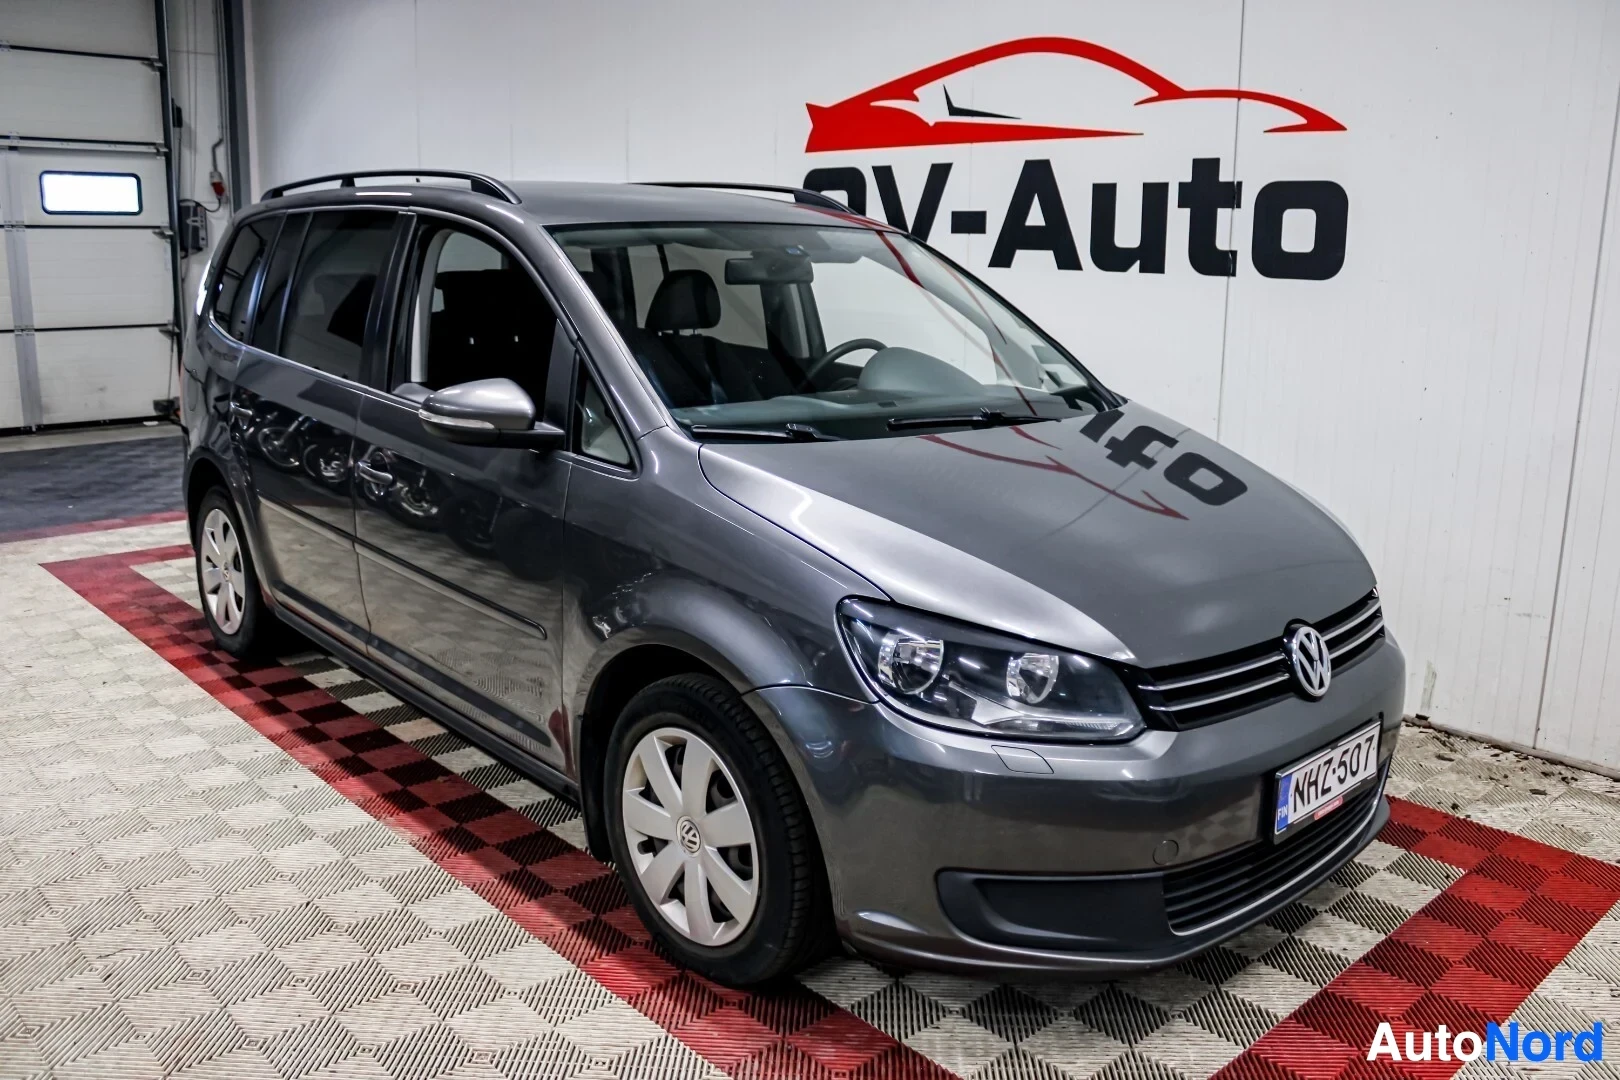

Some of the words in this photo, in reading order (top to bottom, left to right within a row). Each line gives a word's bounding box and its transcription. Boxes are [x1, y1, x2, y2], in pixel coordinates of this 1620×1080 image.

[1293, 626, 1331, 697] VW
[1294, 734, 1375, 814] NHZ-507
[1277, 804, 1288, 821] FIN
